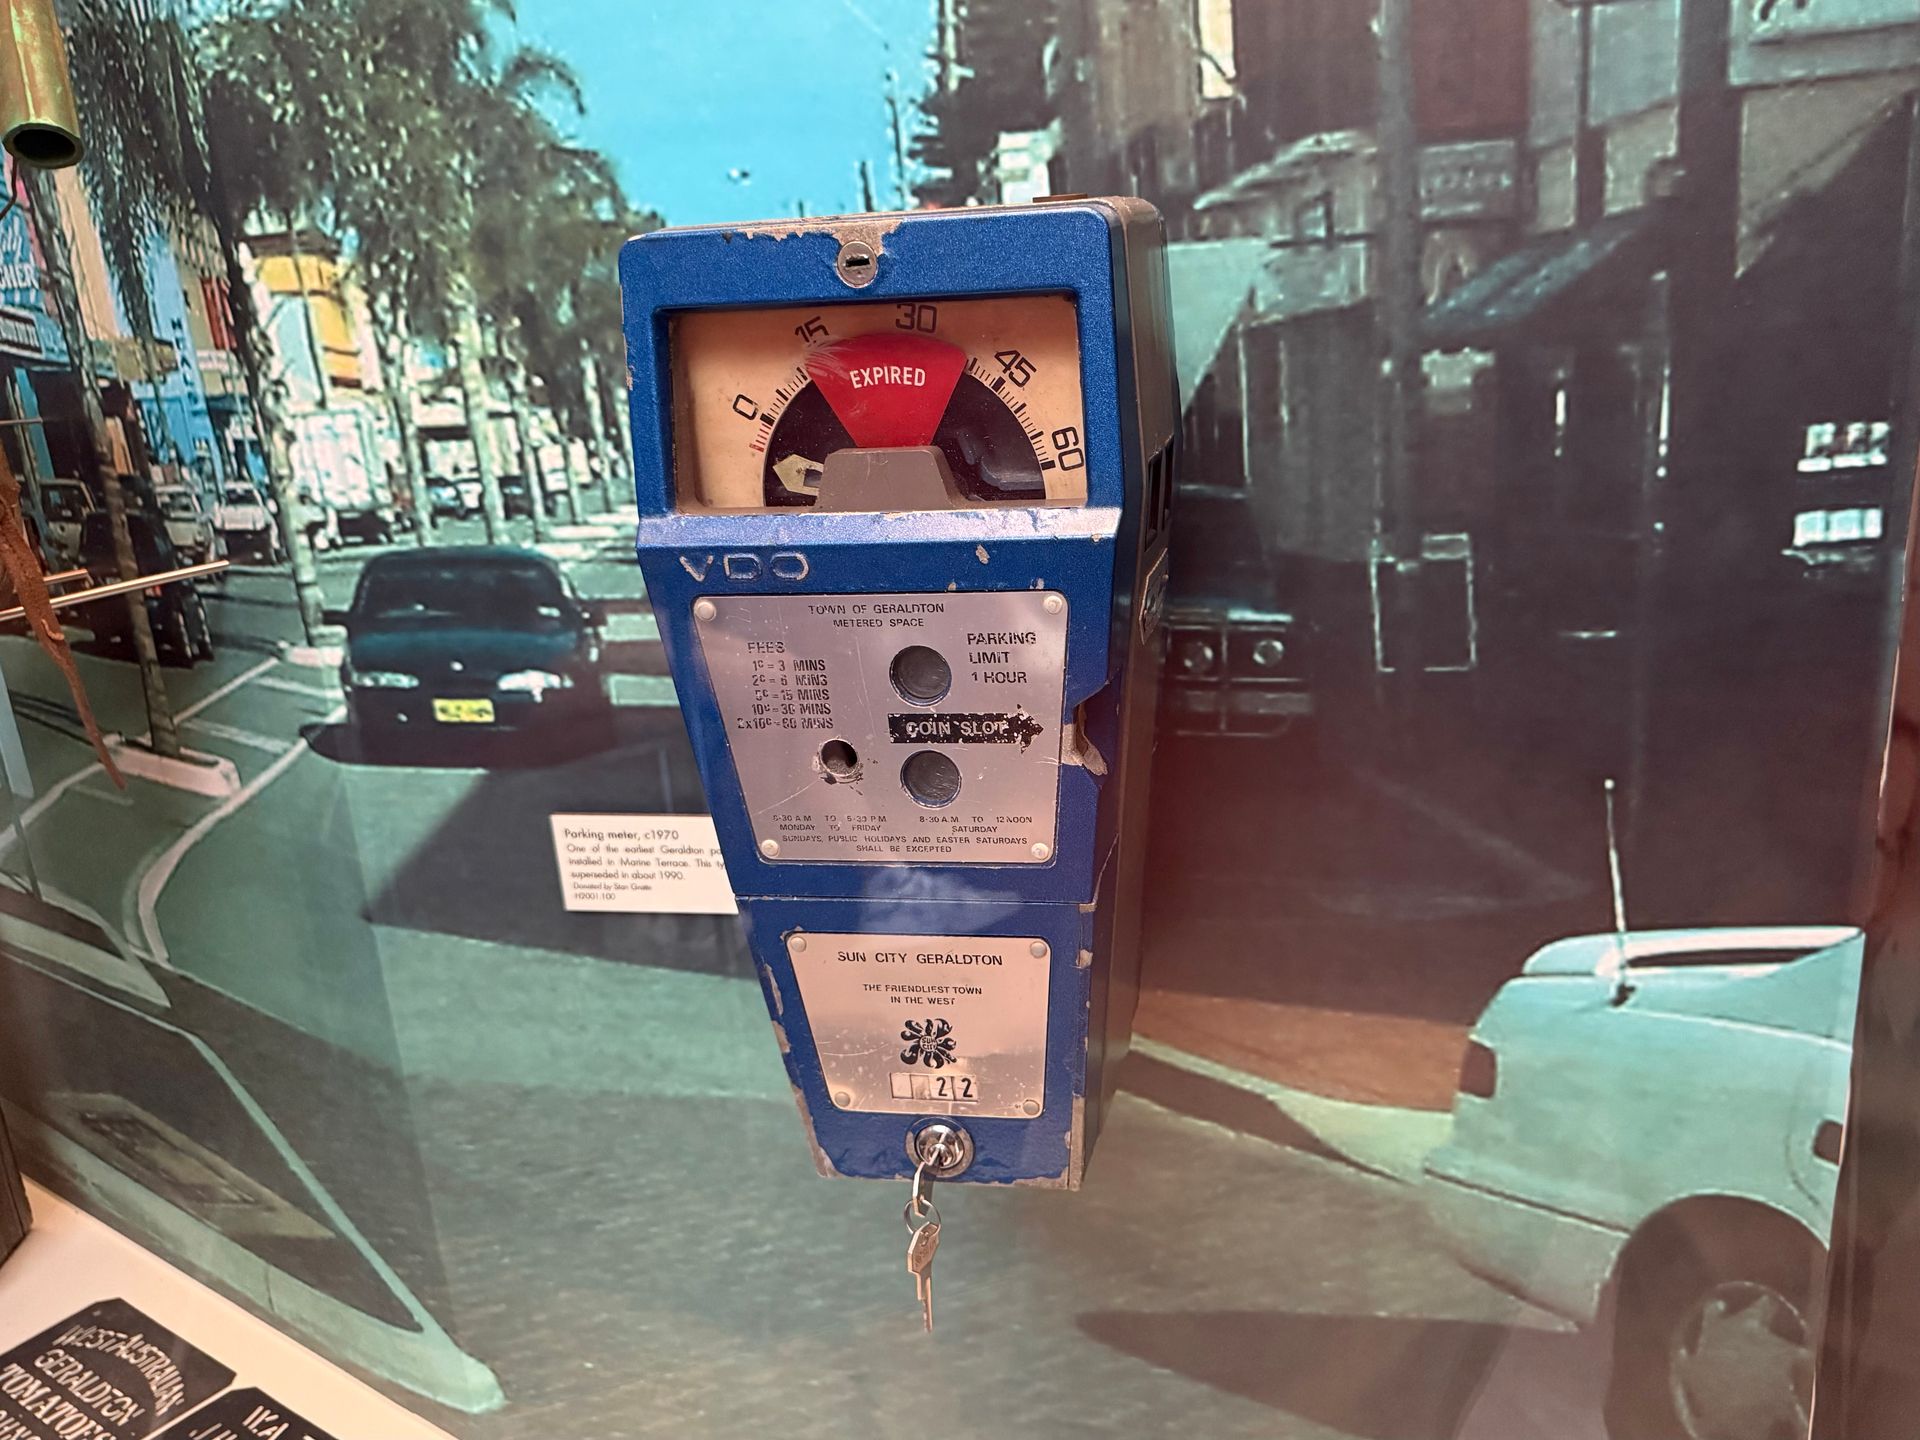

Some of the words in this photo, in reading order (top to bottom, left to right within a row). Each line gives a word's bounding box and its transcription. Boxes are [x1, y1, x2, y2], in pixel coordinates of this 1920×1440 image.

[895, 303, 938, 334] 30
[794, 316, 830, 342] 15
[993, 349, 1037, 388] 45
[849, 366, 926, 390] EXPIRED
[732, 394, 760, 421] 0
[1051, 426, 1084, 472] 60
[678, 552, 810, 583] VDO
[808, 604, 846, 615] TOWN
[852, 604, 868, 615] OF
[873, 603, 945, 615] GERALDTON
[833, 618, 883, 628] METERED
[889, 618, 924, 628] SPACE
[966, 632, 1037, 646] PARKING
[747, 641, 786, 654] FEES
[968, 651, 1011, 665] LIMIT
[793, 659, 826, 671] MINS
[795, 673, 828, 686] MINS
[971, 671, 978, 683] 1
[983, 671, 1028, 684] HOUR
[797, 688, 830, 701] MINS
[799, 703, 832, 715] MINS
[801, 717, 834, 730] MINS
[905, 721, 951, 737] COIN
[960, 720, 1007, 736] SLOT
[779, 823, 816, 831] MONDAY
[852, 824, 881, 832] FRIDAY
[952, 825, 998, 833] SATURDAY
[564, 828, 604, 841] Parking
[608, 830, 641, 841] meter,
[644, 829, 679, 840] c1970
[782, 835, 824, 843] SUNDAYS,
[828, 835, 858, 843] PUBLIC
[864, 835, 907, 843] HOLIDAYS
[912, 836, 931, 844] AND
[936, 836, 970, 844] EASTER
[976, 837, 1028, 845] SATURDAYS
[567, 843, 586, 853] One
[592, 843, 601, 853] of
[606, 843, 619, 853] the
[625, 844, 655, 854] earliest
[660, 844, 705, 854] Geraldton
[906, 845, 952, 853] EXCEPTED
[569, 856, 602, 866] installed
[620, 857, 651, 866] Marine
[697, 858, 712, 867] This
[571, 869, 620, 879] superseded
[632, 870, 656, 879] about
[573, 882, 602, 890] Donated
[604, 882, 613, 891] by
[614, 882, 629, 890] Stan
[837, 951, 867, 963] SUN
[875, 952, 908, 963] CITY
[916, 953, 1003, 966] GERALDTON
[863, 983, 882, 992] THE
[885, 984, 950, 994] FRIENDLIEST
[952, 985, 982, 995] TOWN
[890, 996, 901, 1004] IN
[904, 996, 924, 1005] THE
[927, 997, 956, 1006] WEST
[34, 1348, 146, 1427] GERALDTON
